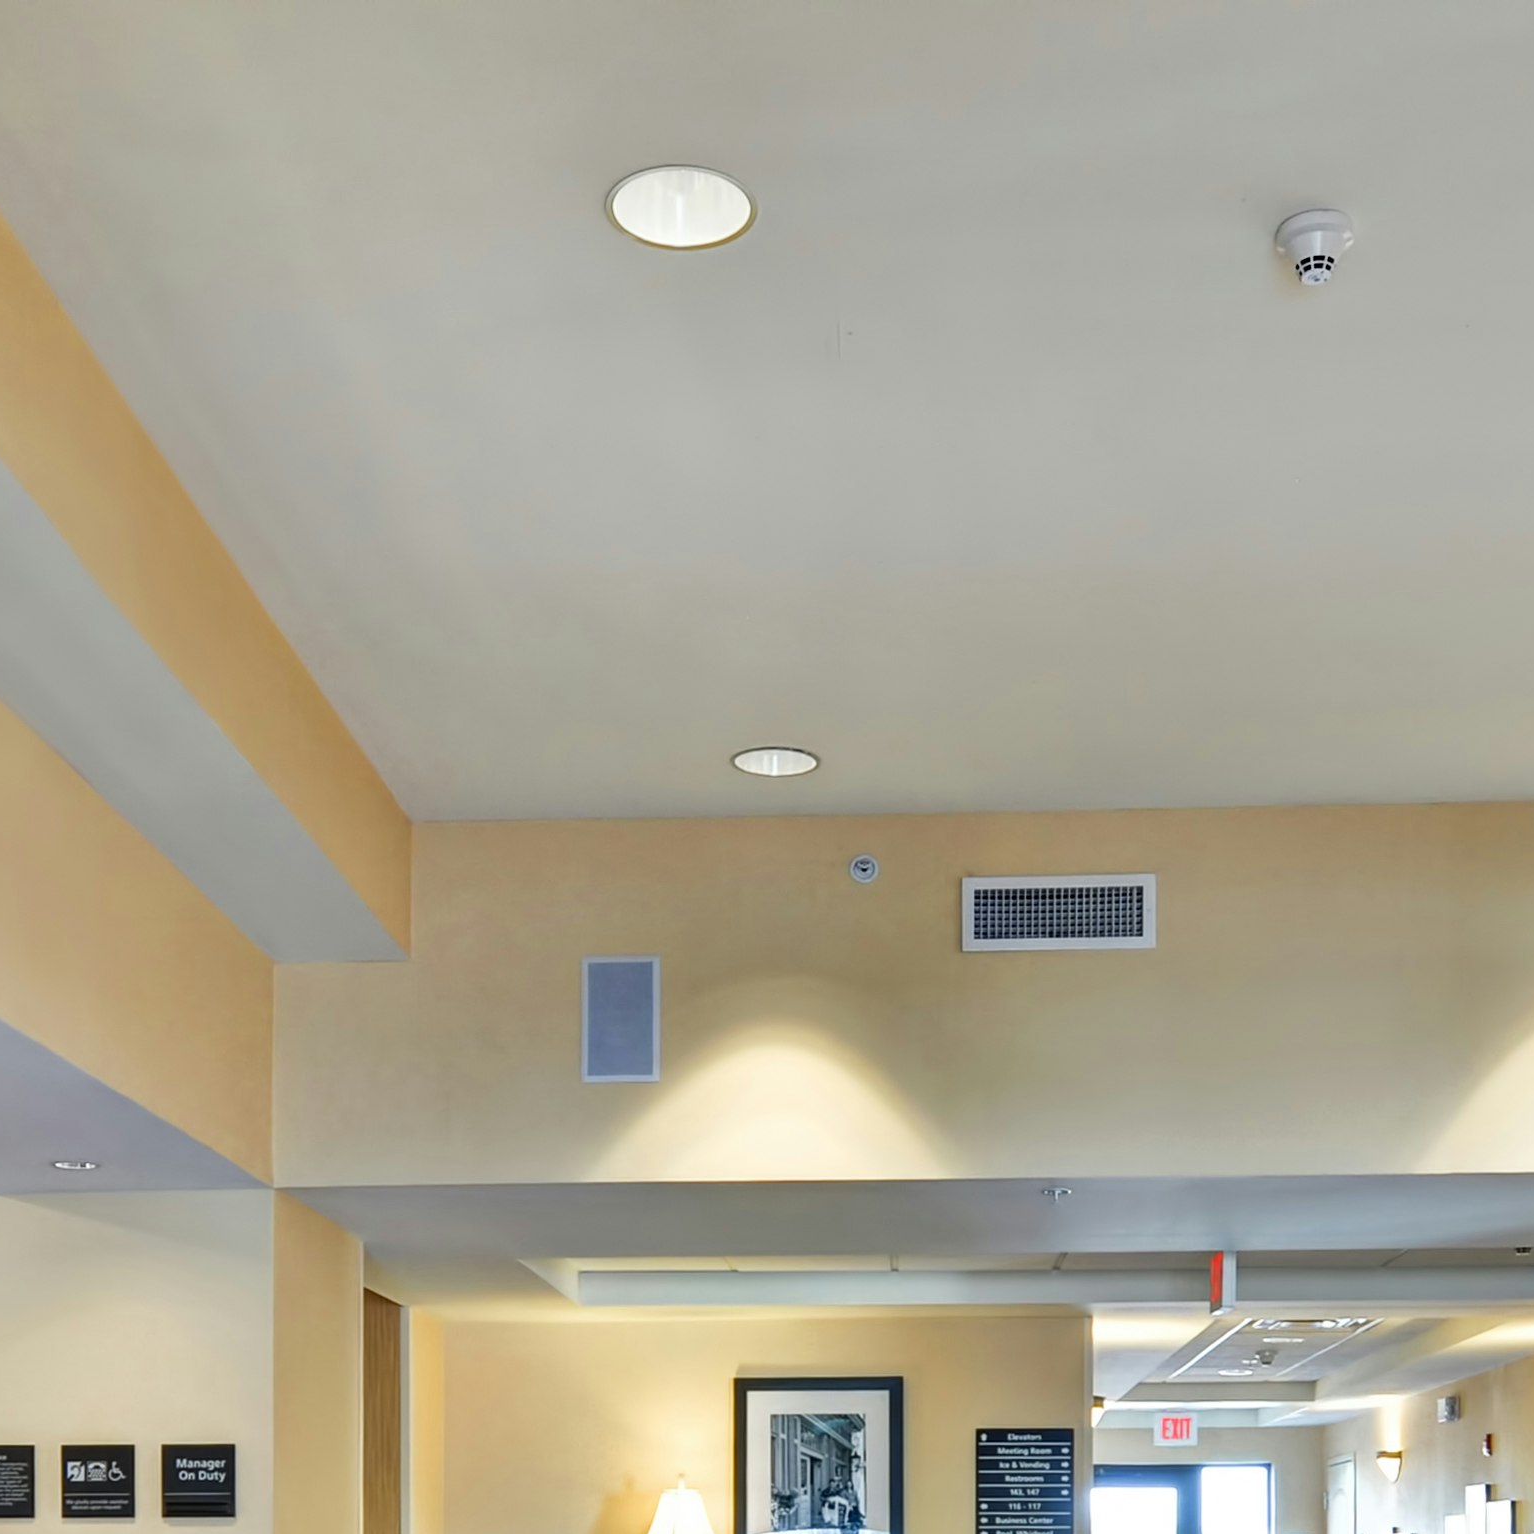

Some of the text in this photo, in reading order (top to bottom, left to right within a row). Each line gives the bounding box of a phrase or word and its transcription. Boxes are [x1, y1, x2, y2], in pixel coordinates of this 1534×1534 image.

[1161, 1417, 1192, 1440] EXIT
[1007, 1433, 1042, 1441] Elevators
[997, 1447, 1029, 1456] Meeting
[176, 1458, 226, 1471] Manager
[1011, 1461, 1018, 1469] &
[1019, 1461, 1050, 1470] Vending
[178, 1470, 226, 1483] On Duty
